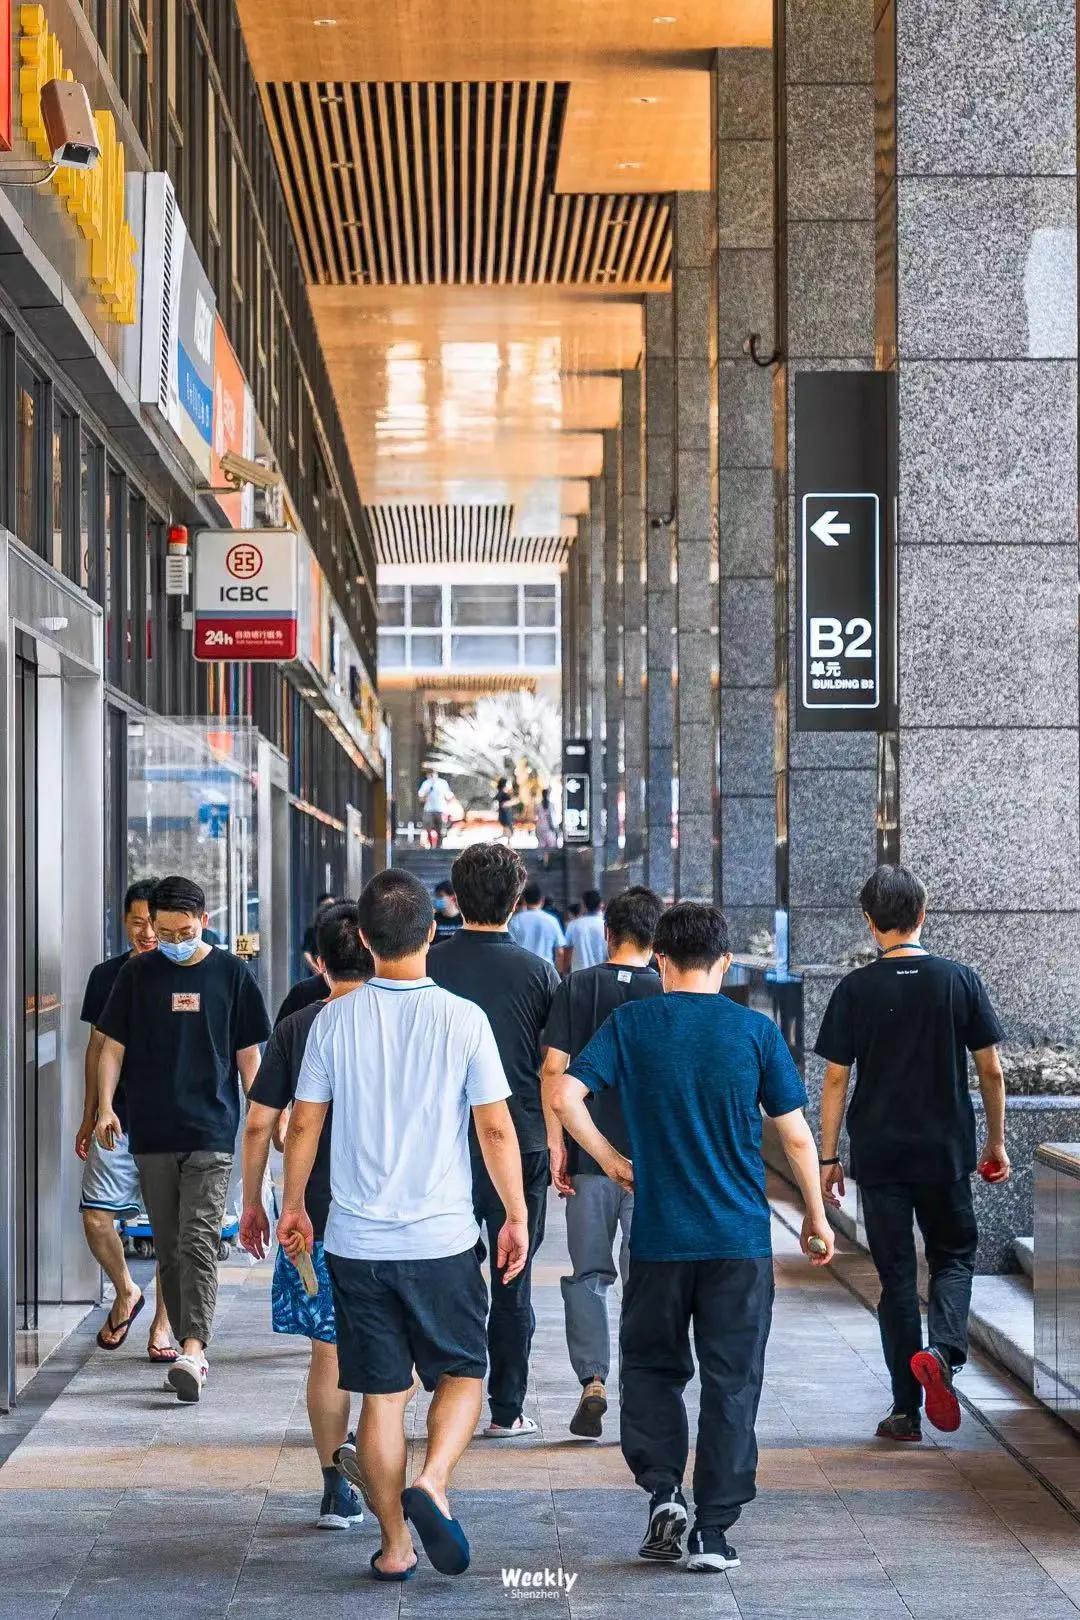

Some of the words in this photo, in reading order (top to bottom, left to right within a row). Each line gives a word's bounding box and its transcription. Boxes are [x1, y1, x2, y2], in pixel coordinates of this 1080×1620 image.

[220, 586, 269, 602] ICBC
[204, 630, 234, 646] 24h
[810, 617, 872, 658] B2
[810, 660, 841, 677] 单元
[812, 679, 860, 690] BUILDING
[860, 679, 875, 690] B2
[564, 808, 588, 827] B1
